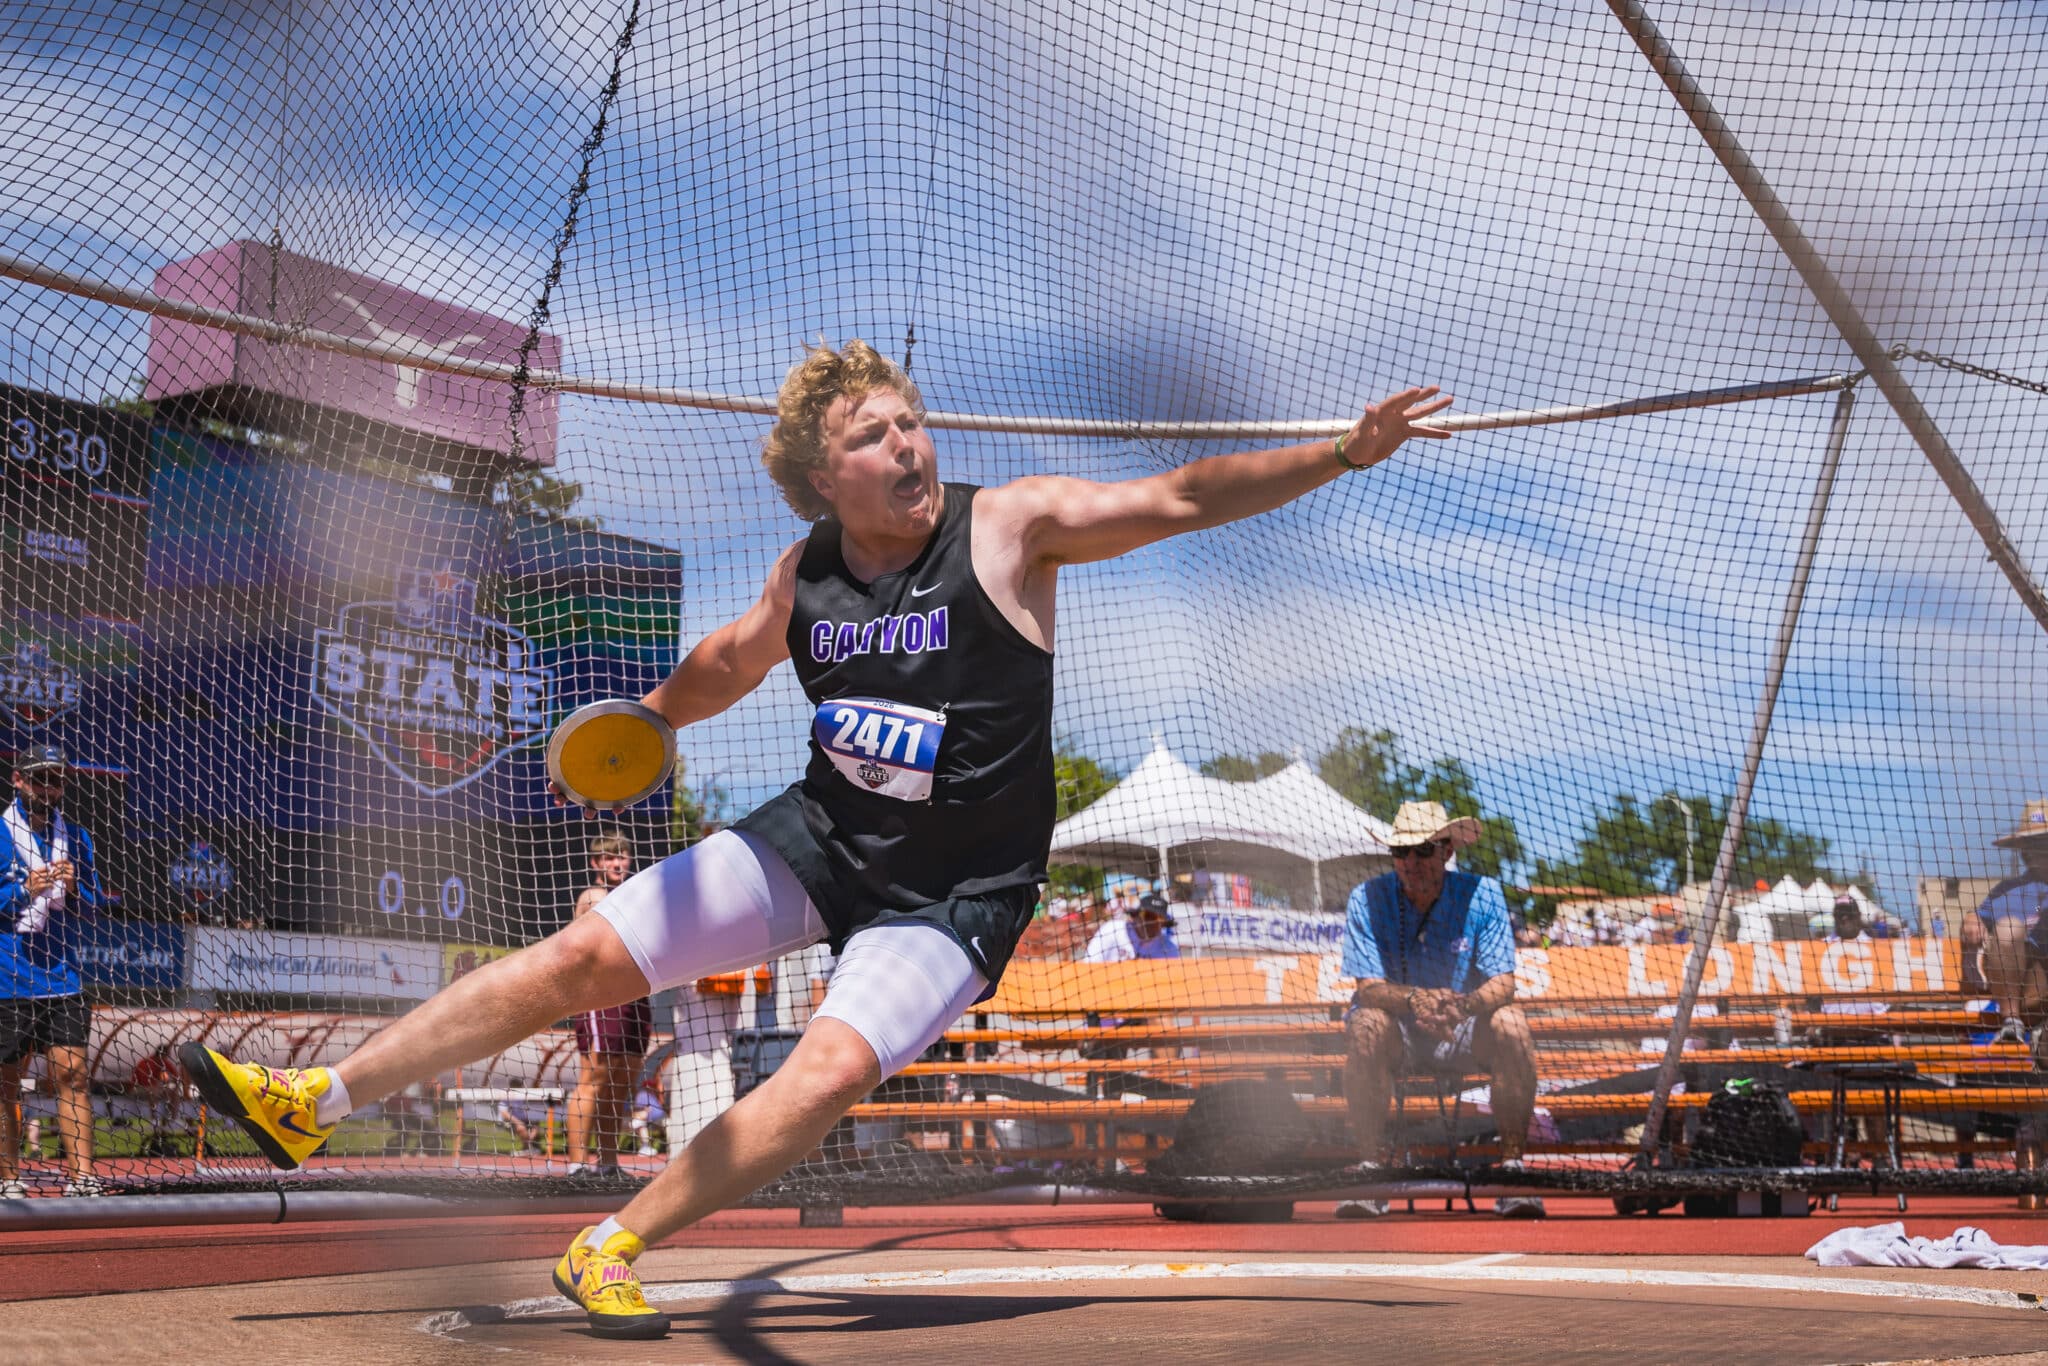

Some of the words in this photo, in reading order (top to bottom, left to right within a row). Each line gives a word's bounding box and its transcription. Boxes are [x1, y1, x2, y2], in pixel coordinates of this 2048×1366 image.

[10, 419, 108, 477] 3:30
[325, 641, 543, 727] STATE
[365, 702, 504, 738] CHAMPIONSHIPS
[832, 707, 925, 764] 2471
[1200, 913, 1261, 939] TATE
[229, 953, 310, 974] American
[313, 956, 377, 977] Airlines
[602, 1264, 635, 1284] NIK
